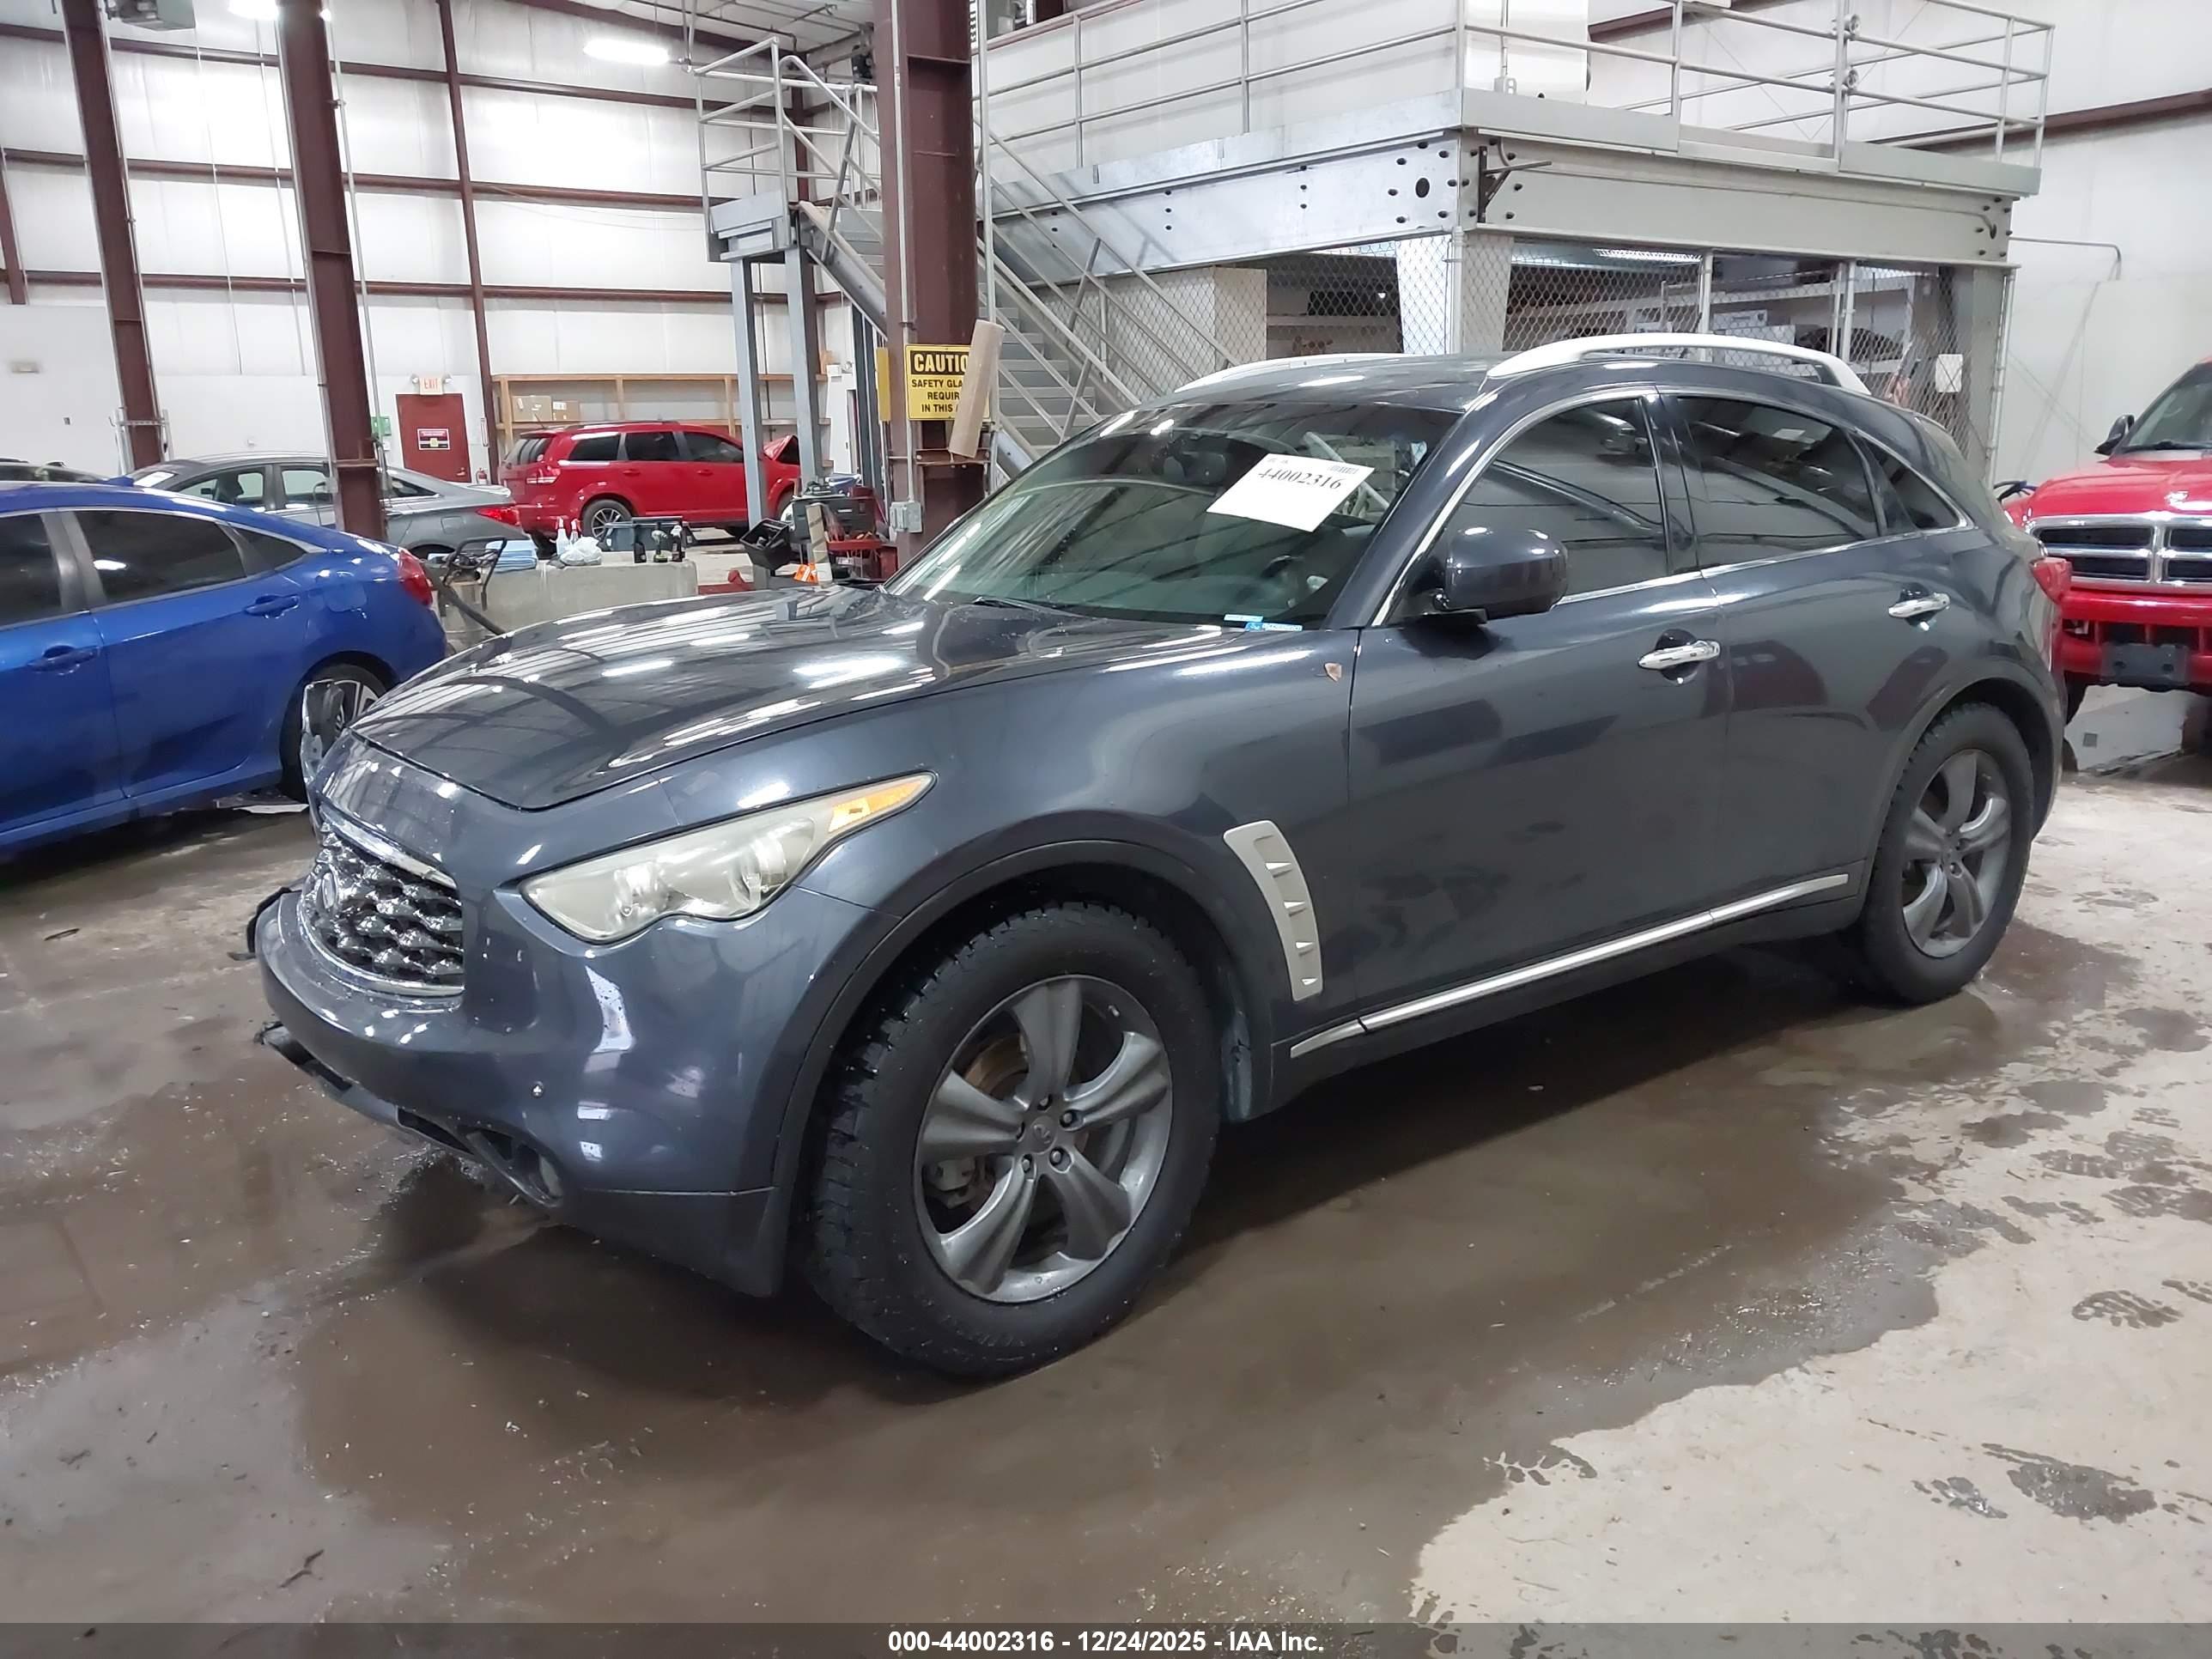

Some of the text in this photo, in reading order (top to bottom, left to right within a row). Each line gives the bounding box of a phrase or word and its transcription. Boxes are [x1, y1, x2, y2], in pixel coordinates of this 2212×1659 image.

[914, 354, 969, 373] CAUTIO
[911, 379, 963, 388] SAFETY GLA
[927, 392, 960, 400] REQUIR
[921, 404, 931, 412] IN
[933, 404, 953, 412] THIS
[1258, 468, 1346, 489] 44002316
